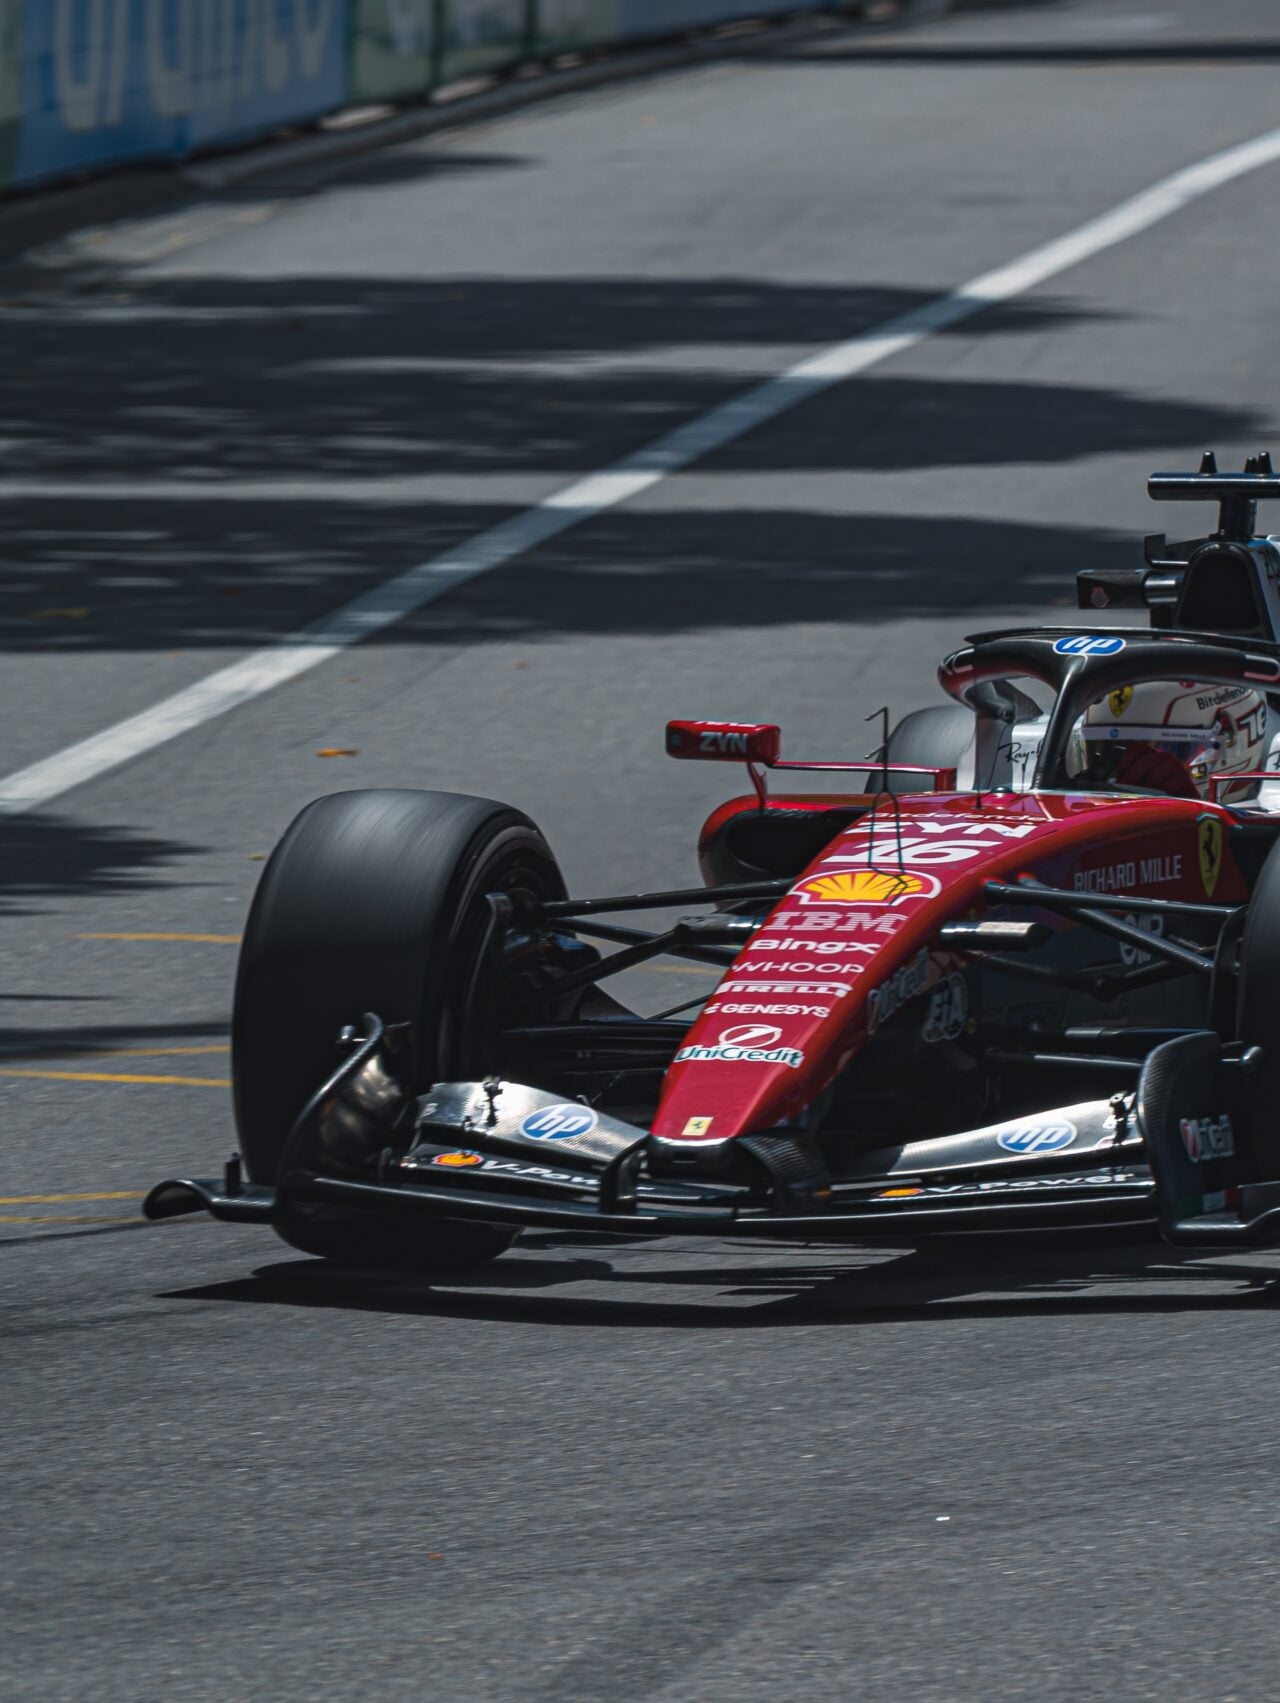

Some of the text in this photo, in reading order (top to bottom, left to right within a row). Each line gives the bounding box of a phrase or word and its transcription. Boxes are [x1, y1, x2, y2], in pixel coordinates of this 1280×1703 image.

[1061, 635, 1119, 655] hp
[700, 730, 750, 753] ZYN
[865, 812, 1048, 822] Bitdefende
[843, 821, 1038, 839] ZYN
[820, 837, 1004, 864] 16
[1073, 854, 1182, 893] RICHARD MILLE
[762, 911, 909, 935] IBM
[731, 961, 865, 974] WHOOP
[714, 980, 853, 998] PIRELLI
[720, 1002, 831, 1018] GENESYS
[674, 1044, 804, 1069] UniCredit
[526, 1104, 592, 1140] hp
[1005, 1121, 1070, 1152] hp
[480, 1160, 601, 1186] V-Pow
[924, 1172, 1135, 1193] V-Power
